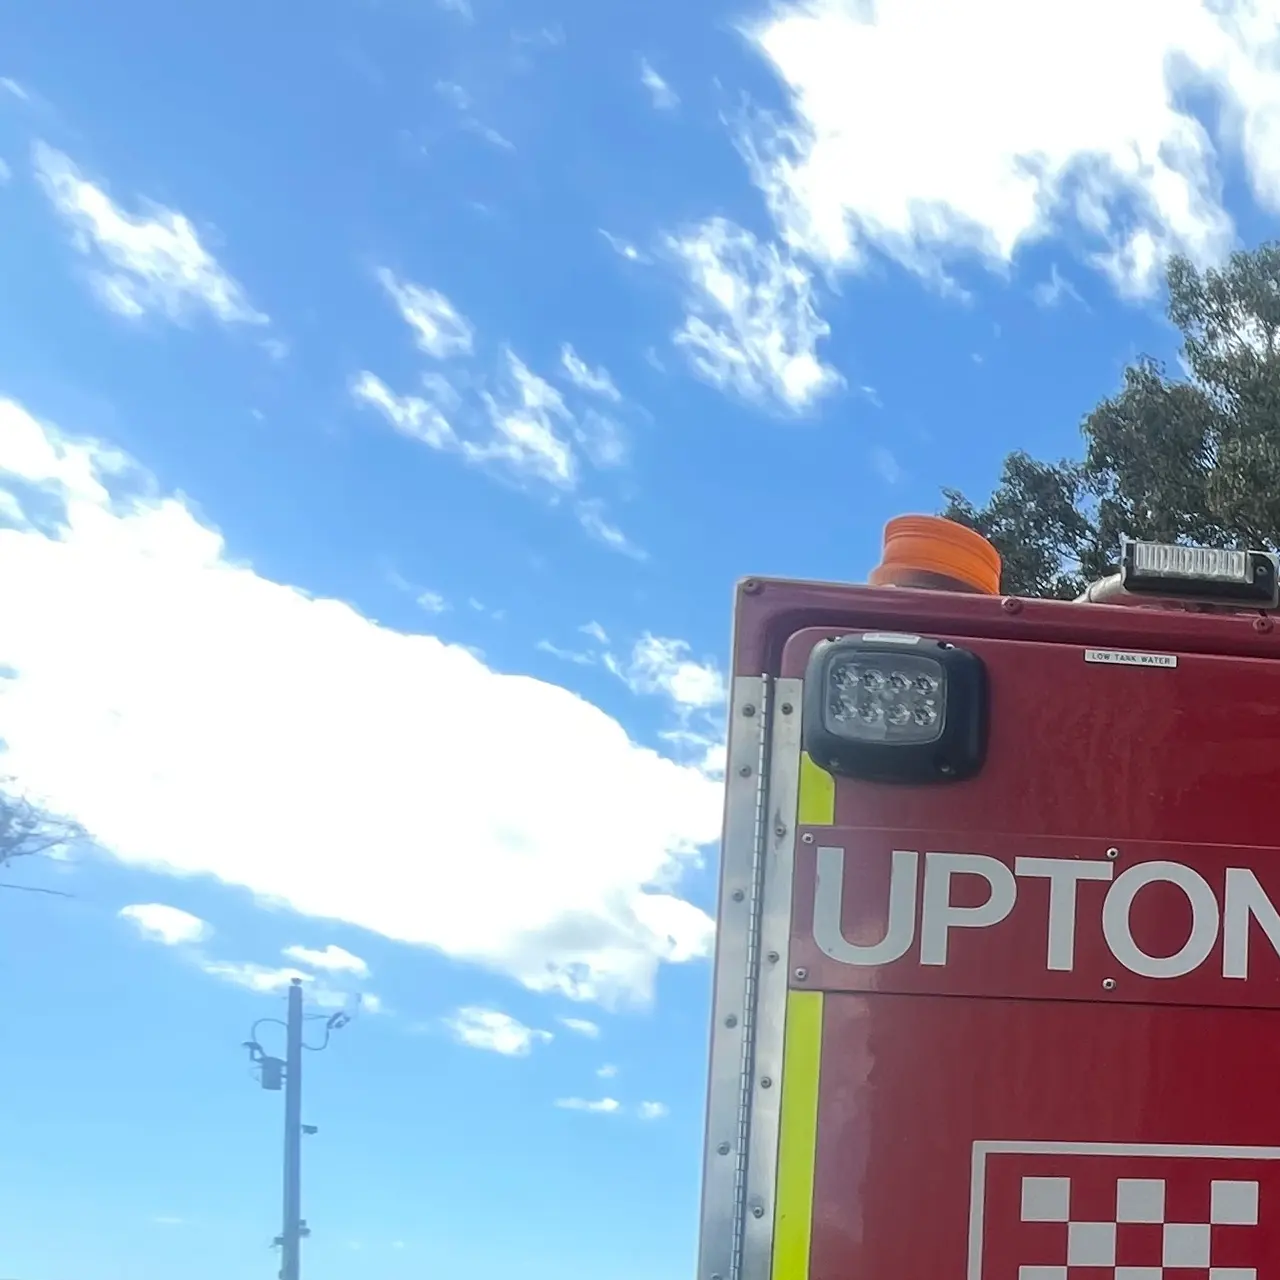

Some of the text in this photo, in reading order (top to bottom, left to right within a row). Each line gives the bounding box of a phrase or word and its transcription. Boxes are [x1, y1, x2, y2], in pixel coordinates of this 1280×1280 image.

[1092, 653, 1170, 665] LOW TANK WATER
